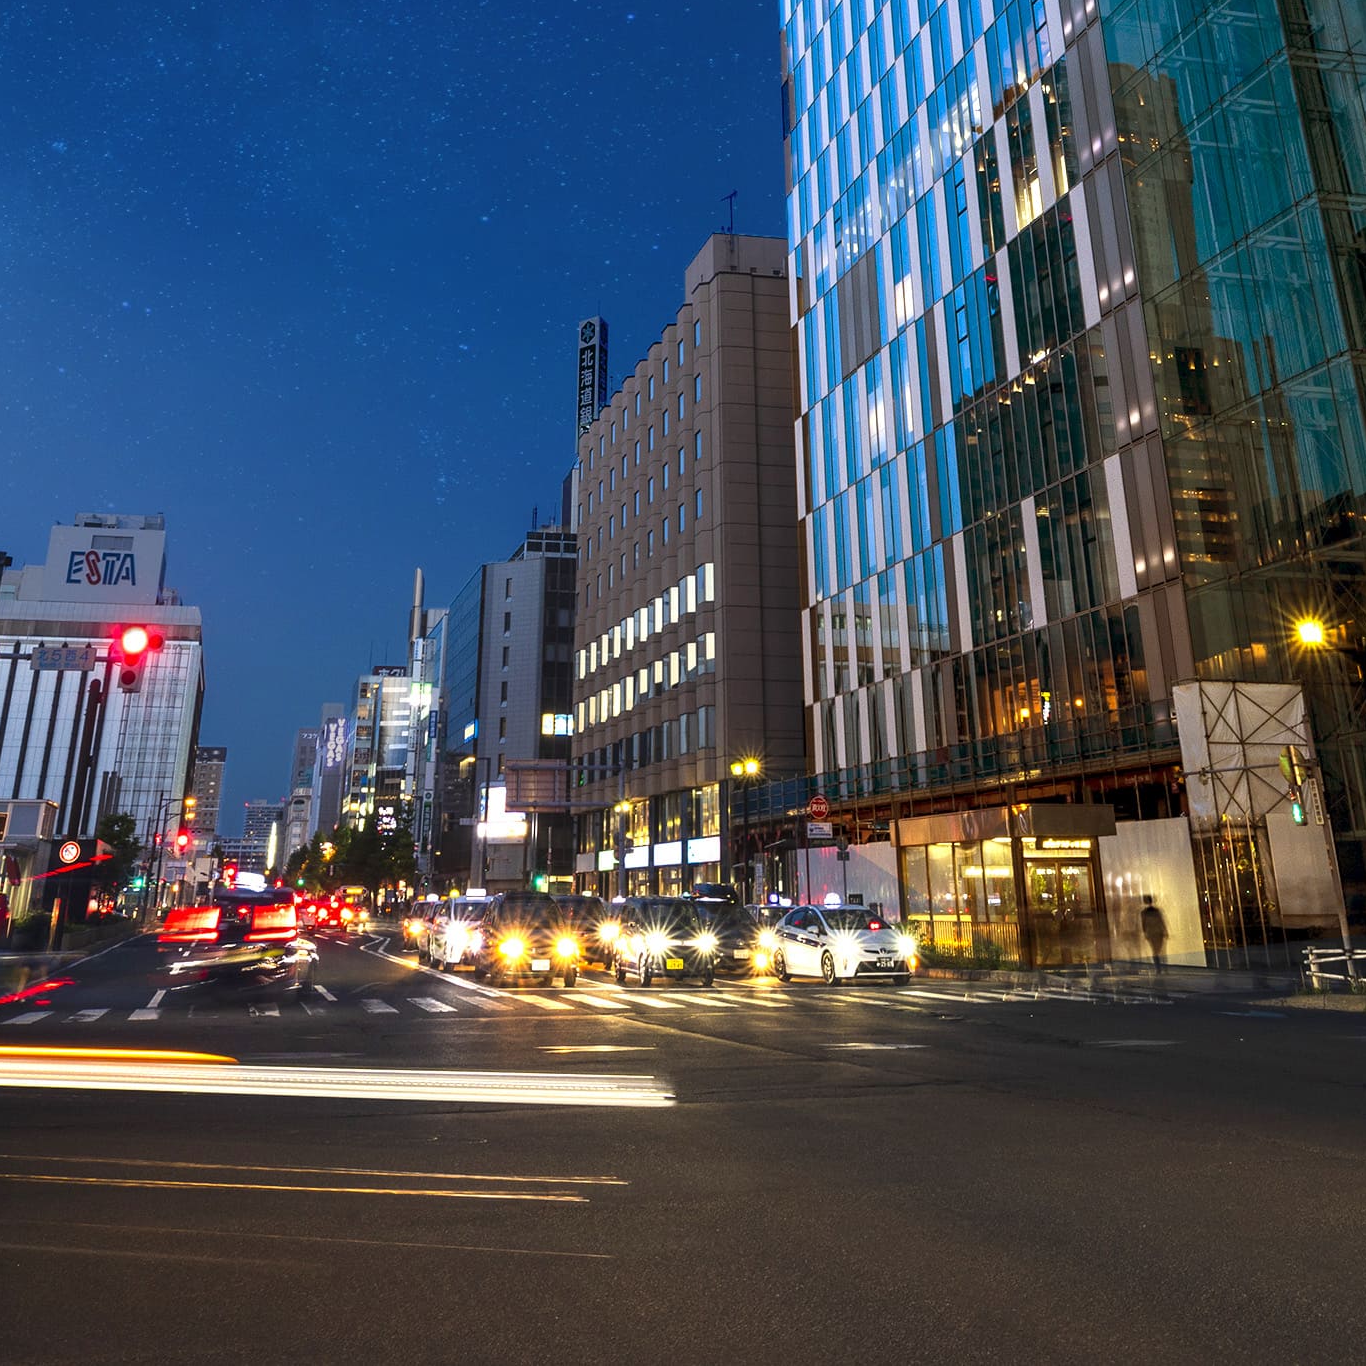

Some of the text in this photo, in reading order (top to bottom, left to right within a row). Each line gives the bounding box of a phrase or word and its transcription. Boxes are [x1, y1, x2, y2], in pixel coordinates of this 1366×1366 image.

[66, 550, 136, 586] ESTA
[37, 648, 91, 661] 北5西4
[326, 723, 337, 767] VEGAS
[335, 718, 346, 762] VEGAS
